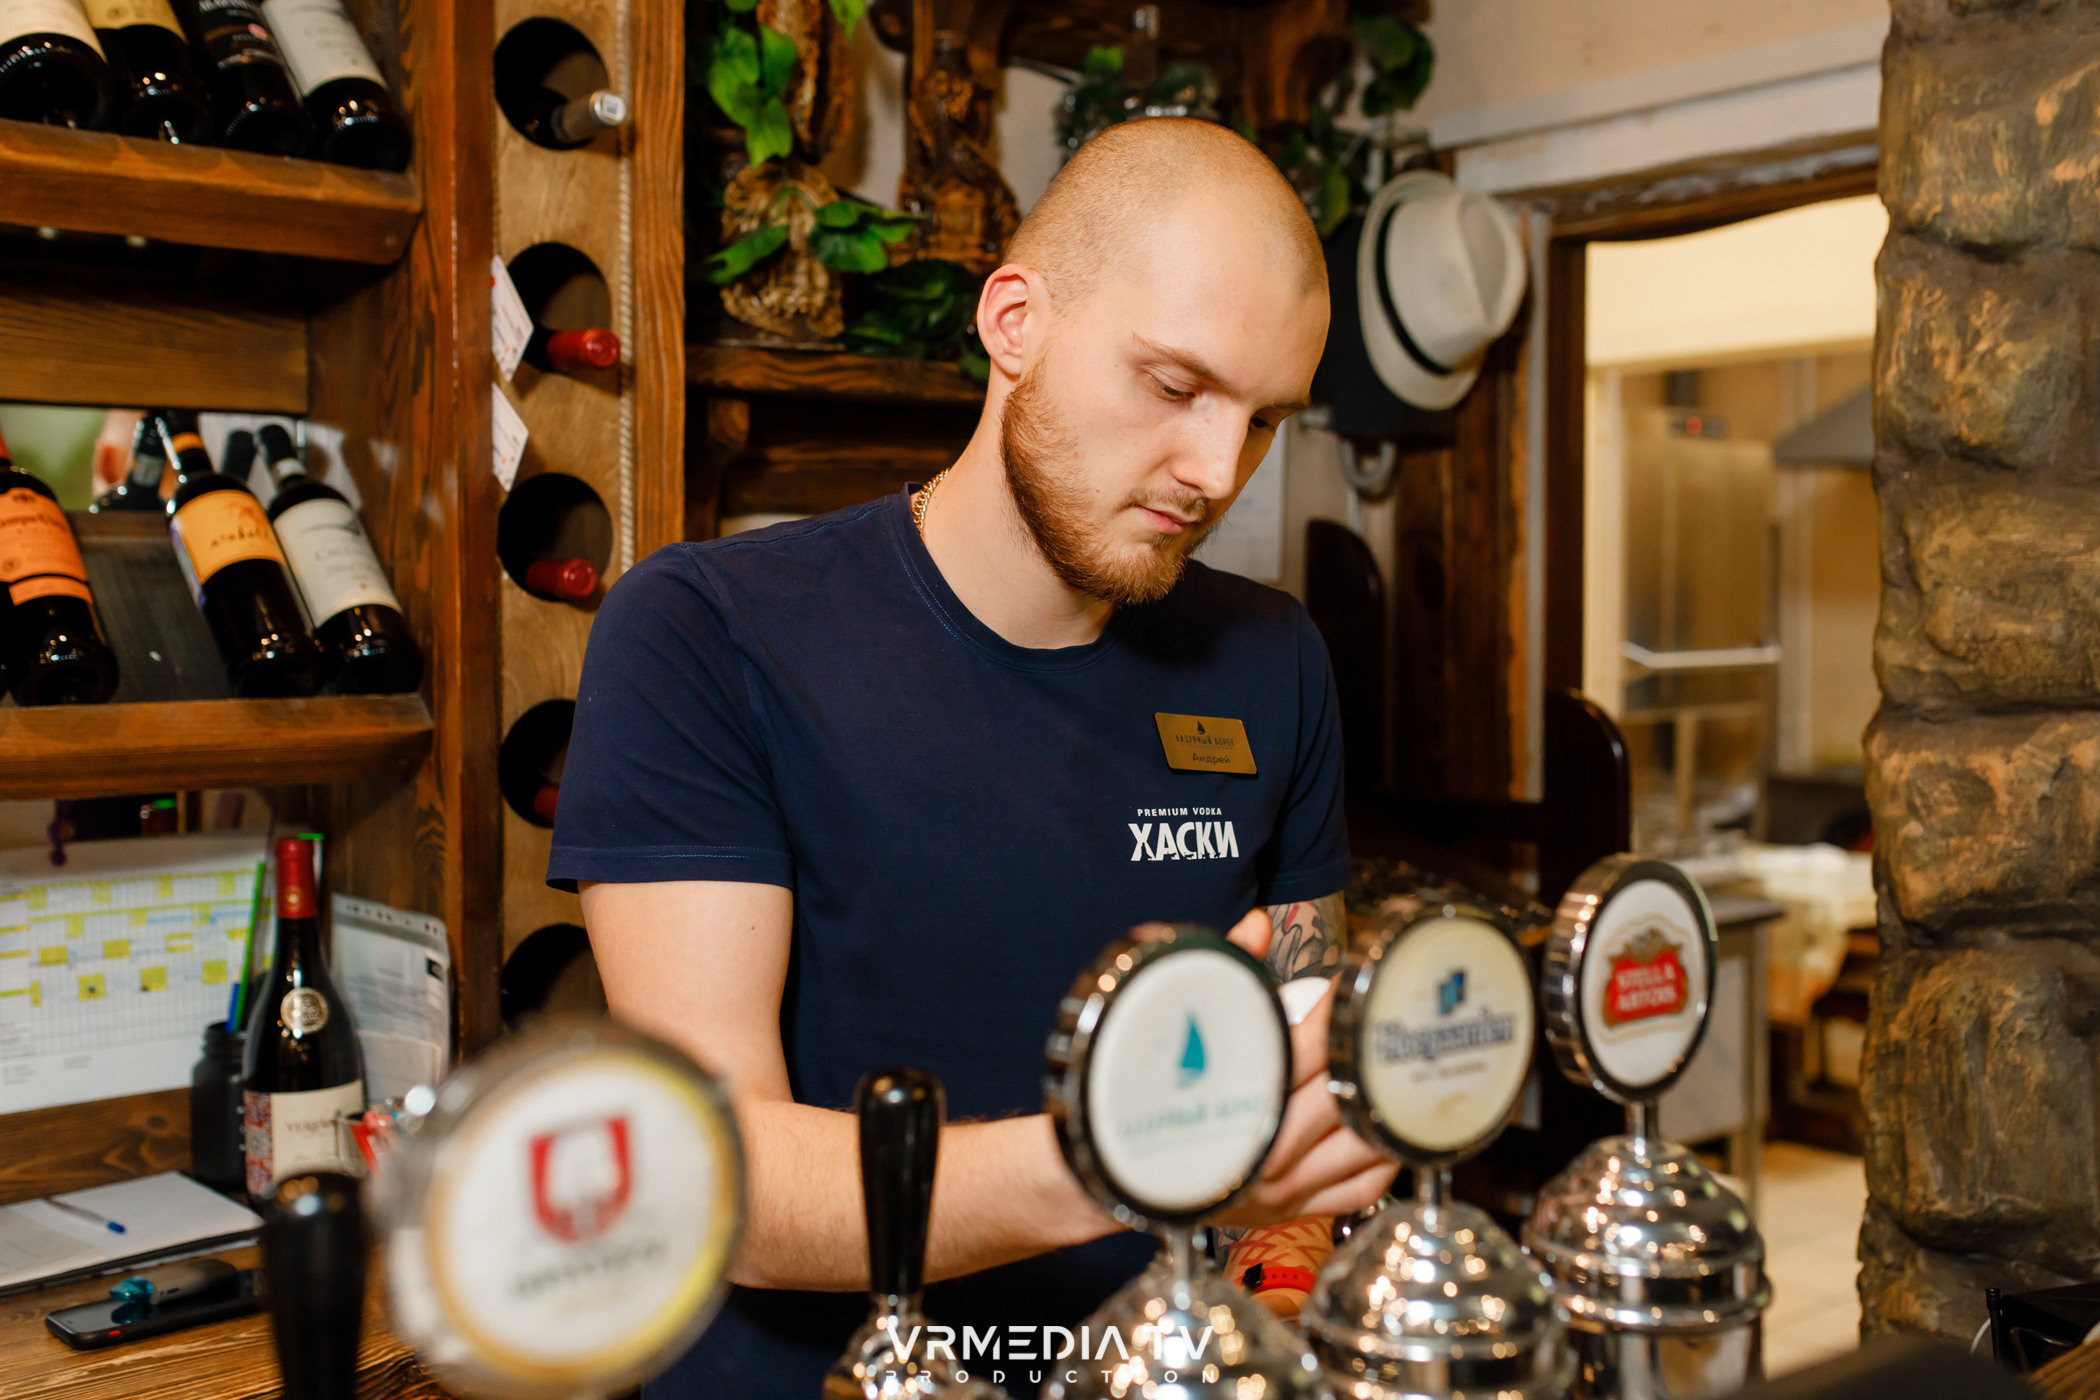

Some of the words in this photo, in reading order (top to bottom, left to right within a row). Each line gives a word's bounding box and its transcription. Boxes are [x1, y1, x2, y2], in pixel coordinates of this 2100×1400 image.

[1214, 737, 1234, 746] БЕРЕГ
[1192, 752, 1231, 764] Андрей
[1137, 807, 1188, 817] PREMIUM
[1192, 806, 1222, 816] VODKA
[1128, 820, 1240, 862] ХАСКИ
